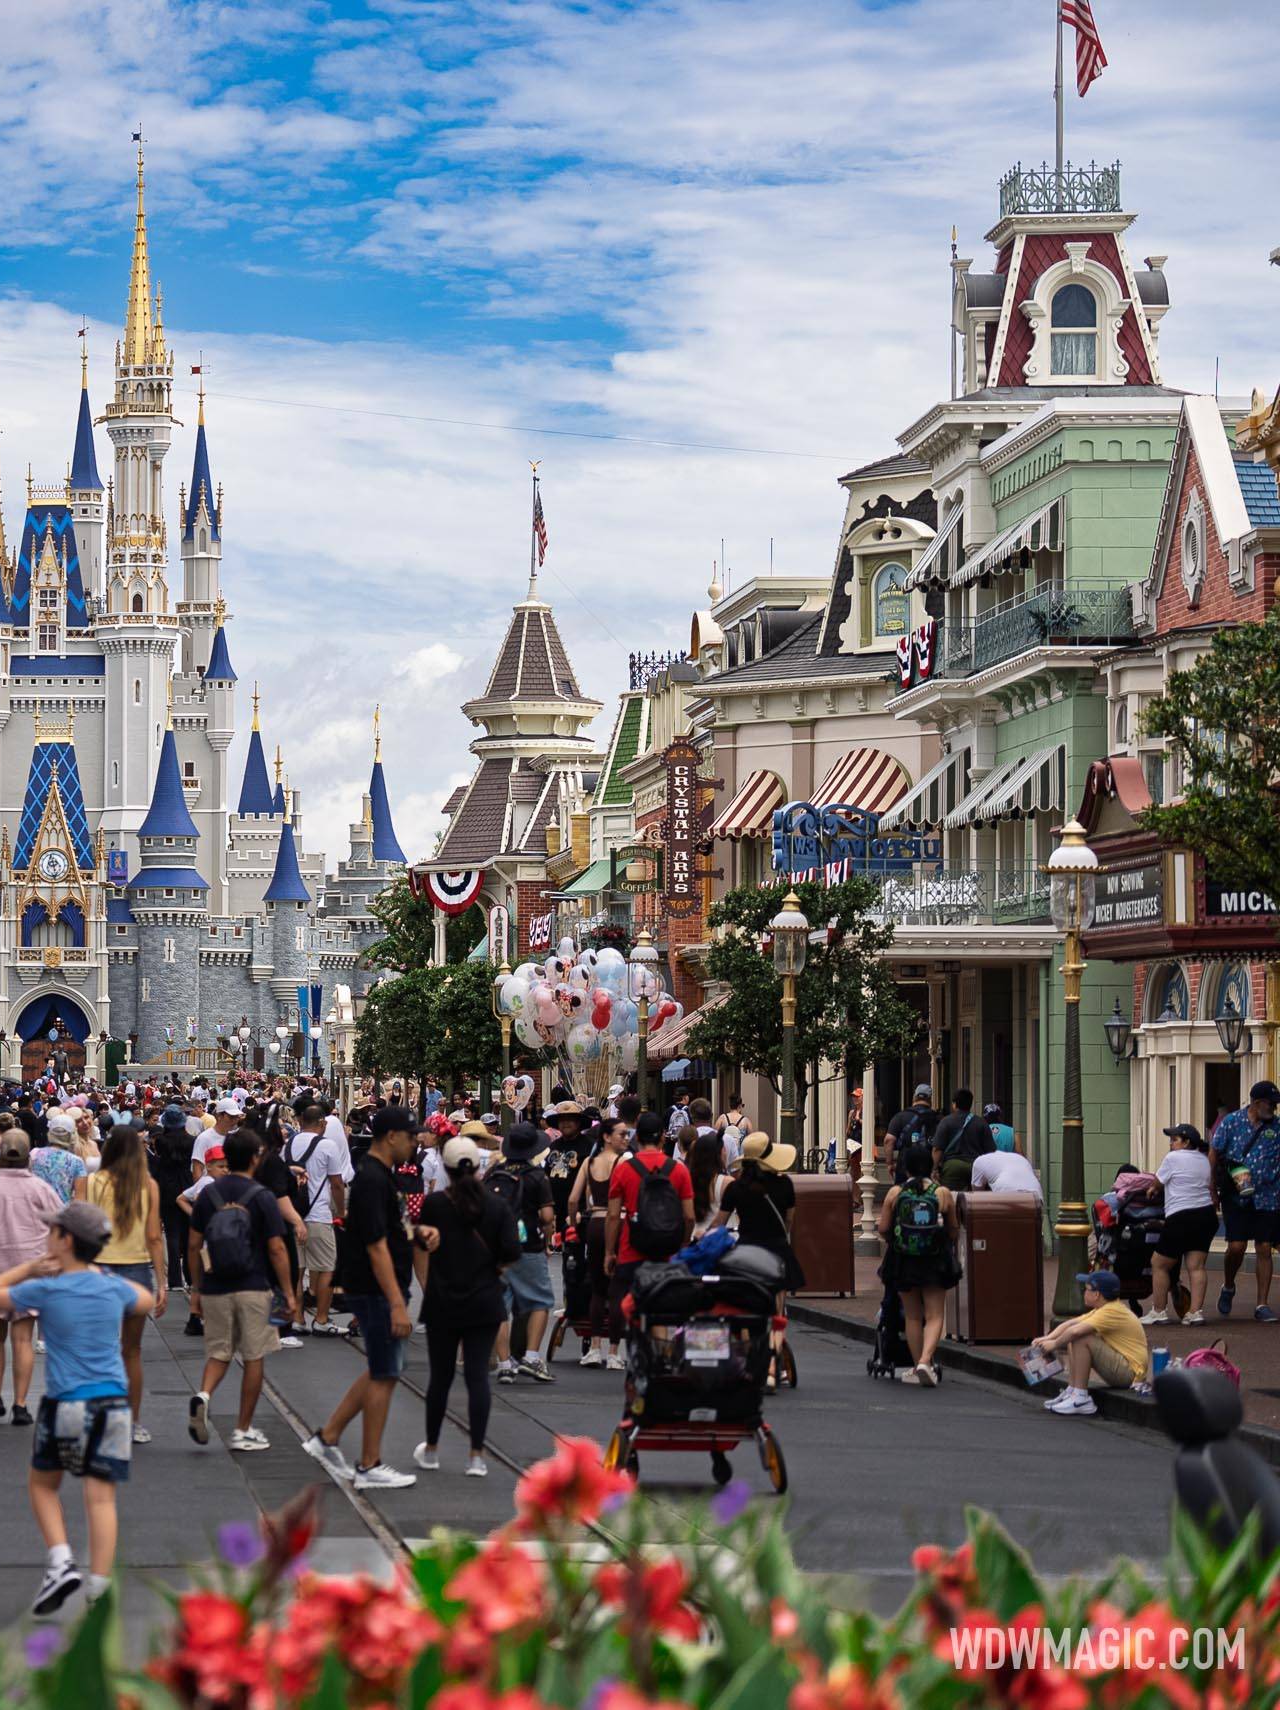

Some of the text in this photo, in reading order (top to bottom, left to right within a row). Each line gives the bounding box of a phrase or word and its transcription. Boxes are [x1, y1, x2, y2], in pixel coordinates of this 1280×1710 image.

[673, 765, 690, 893] CRYSTAL ARTS
[621, 881, 652, 892] COFFEE
[1107, 871, 1144, 895] NOW SHOWING
[1095, 903, 1114, 923] MICKEY
